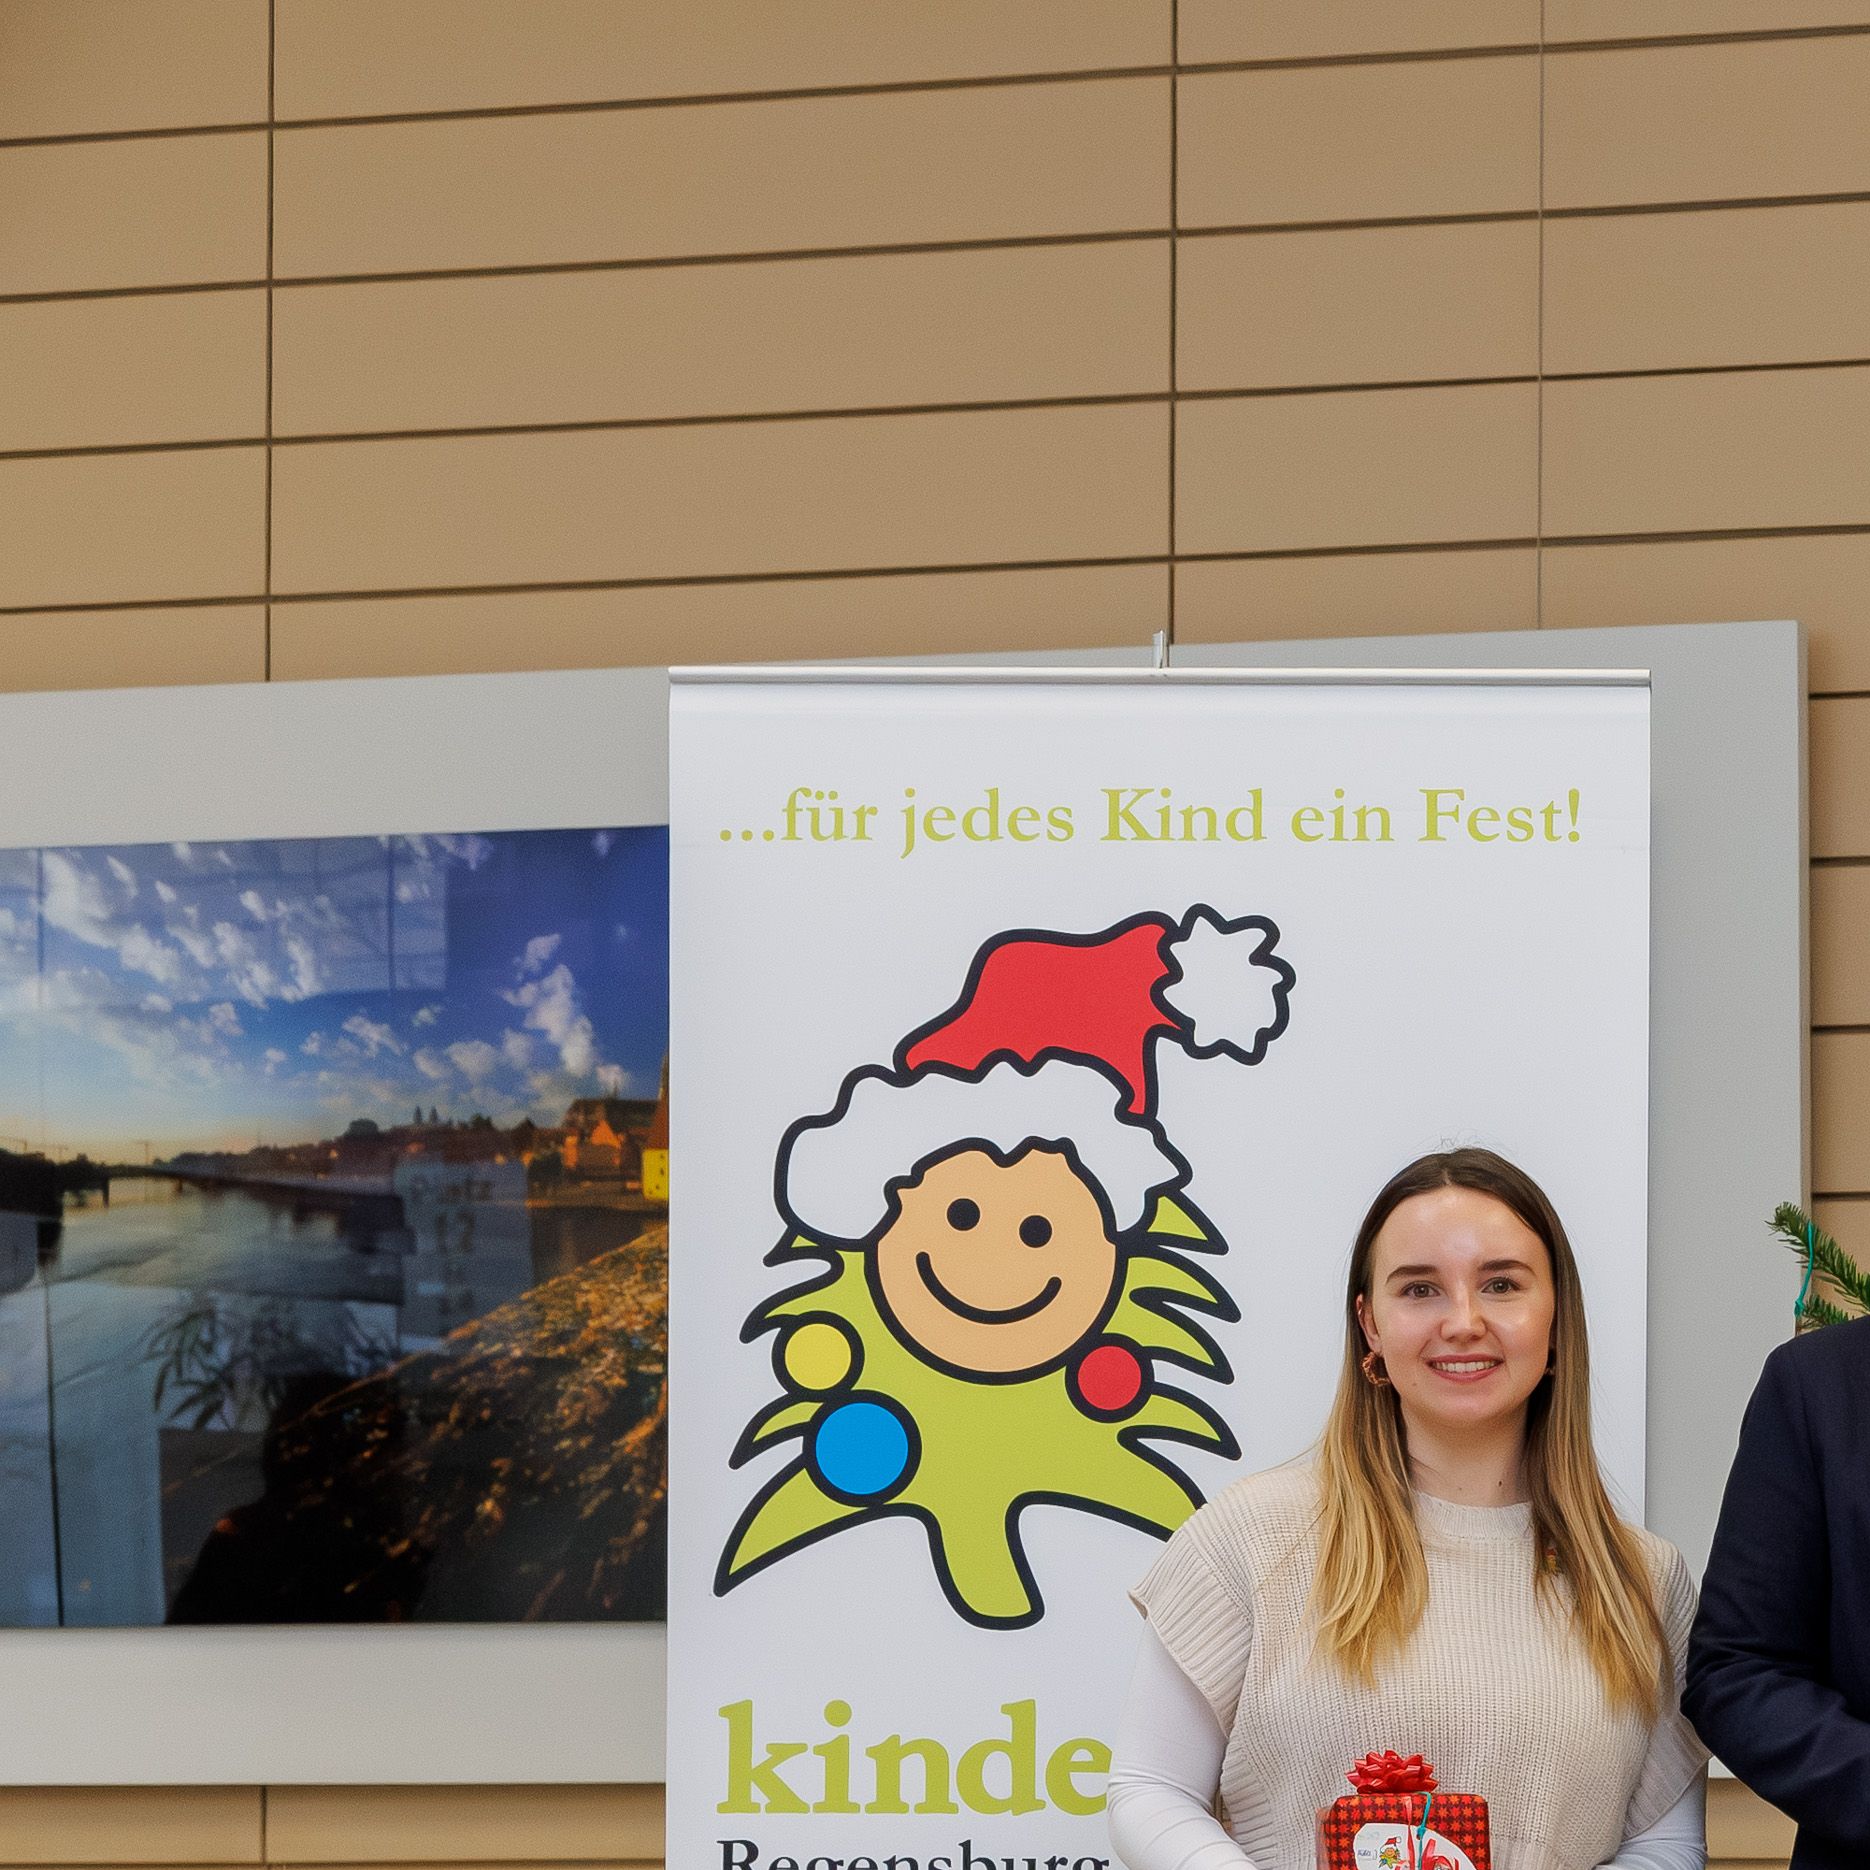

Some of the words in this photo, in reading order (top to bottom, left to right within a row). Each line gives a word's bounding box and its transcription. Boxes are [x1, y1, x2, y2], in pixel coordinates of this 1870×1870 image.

[899, 788, 1074, 860] jedes
[1100, 787, 1268, 842] Kind
[1290, 788, 1395, 842] ein
[1419, 787, 1583, 842] Fest!
[716, 1699, 1112, 1817] kinde
